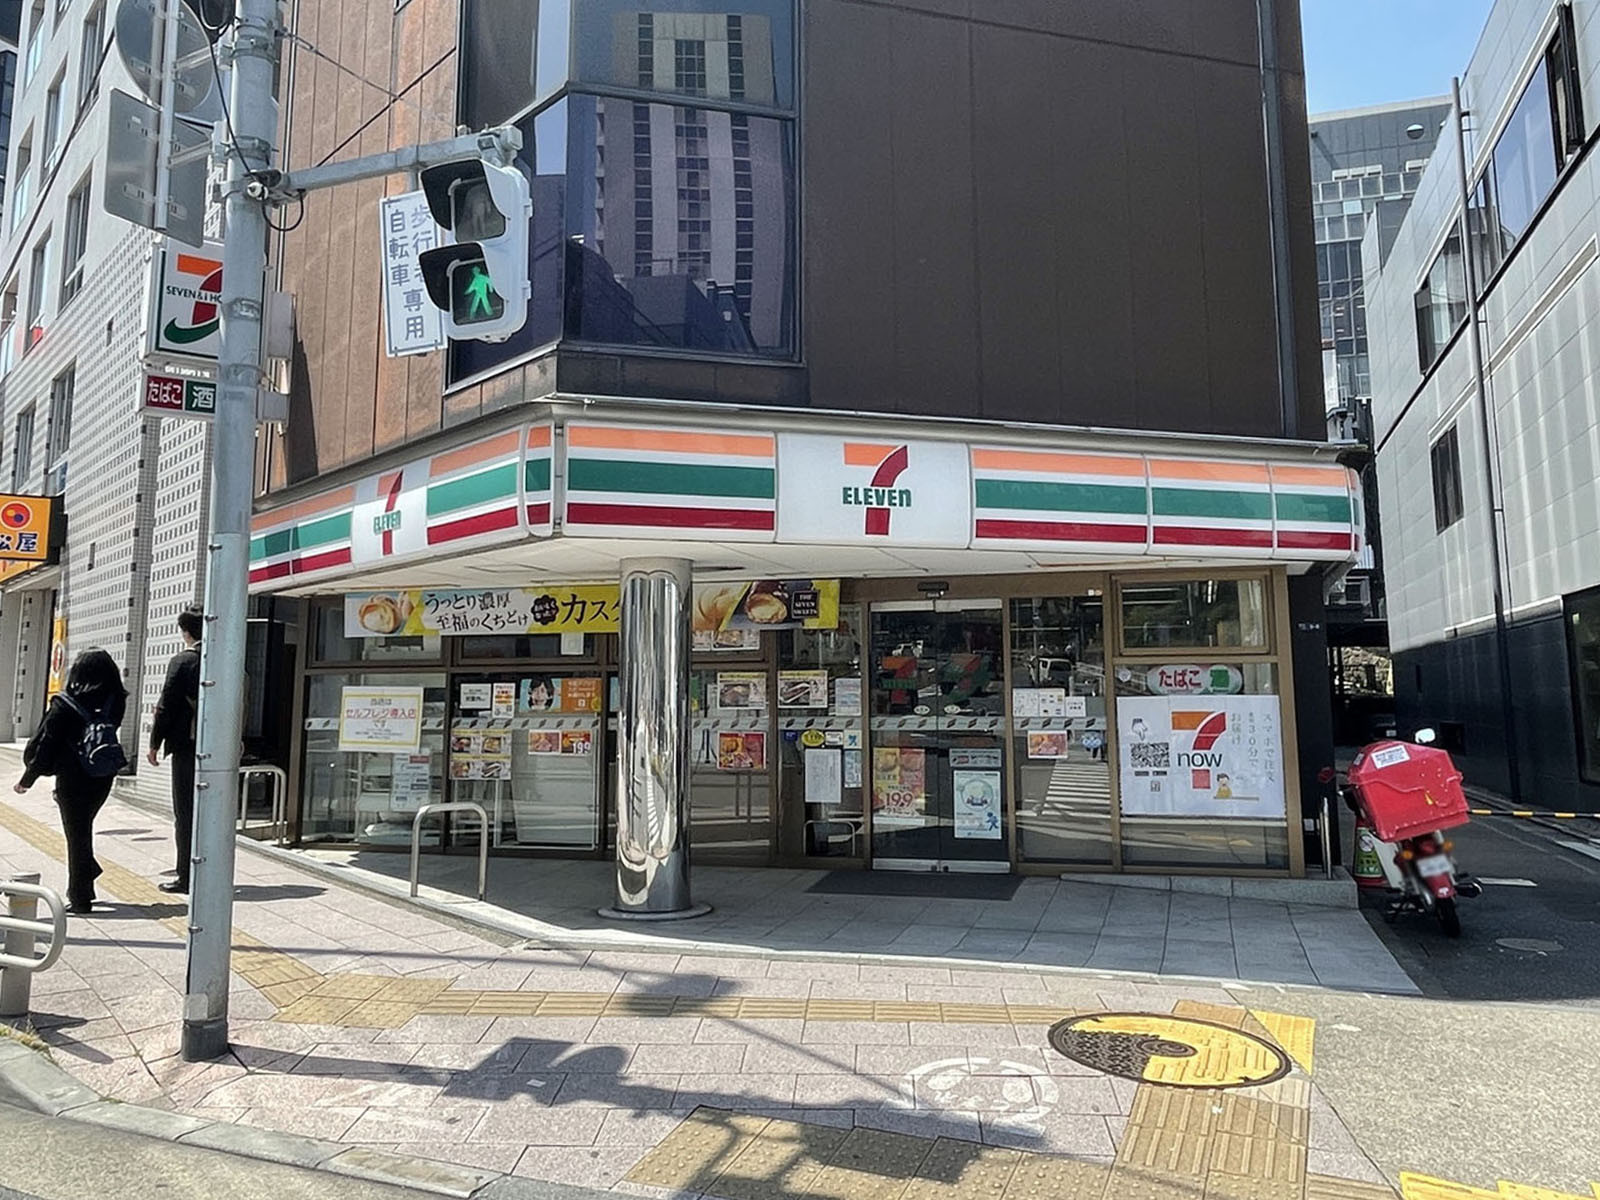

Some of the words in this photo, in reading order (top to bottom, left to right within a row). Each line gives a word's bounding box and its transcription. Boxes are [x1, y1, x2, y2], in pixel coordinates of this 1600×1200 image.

[389, 209, 410, 286] 自転車
[166, 285, 196, 299] SEVEN
[403, 289, 424, 341] 専用
[149, 380, 183, 405] たばこ
[192, 385, 214, 409] 酒
[843, 442, 908, 536] 7
[425, 592, 511, 615] うっとり濃厚
[436, 610, 528, 632] 至福のくちどけ
[1158, 669, 1202, 688] たばこ
[346, 708, 416, 719] セルフレジ導入店
[573, 741, 591, 755] 199
[1177, 752, 1223, 768] now
